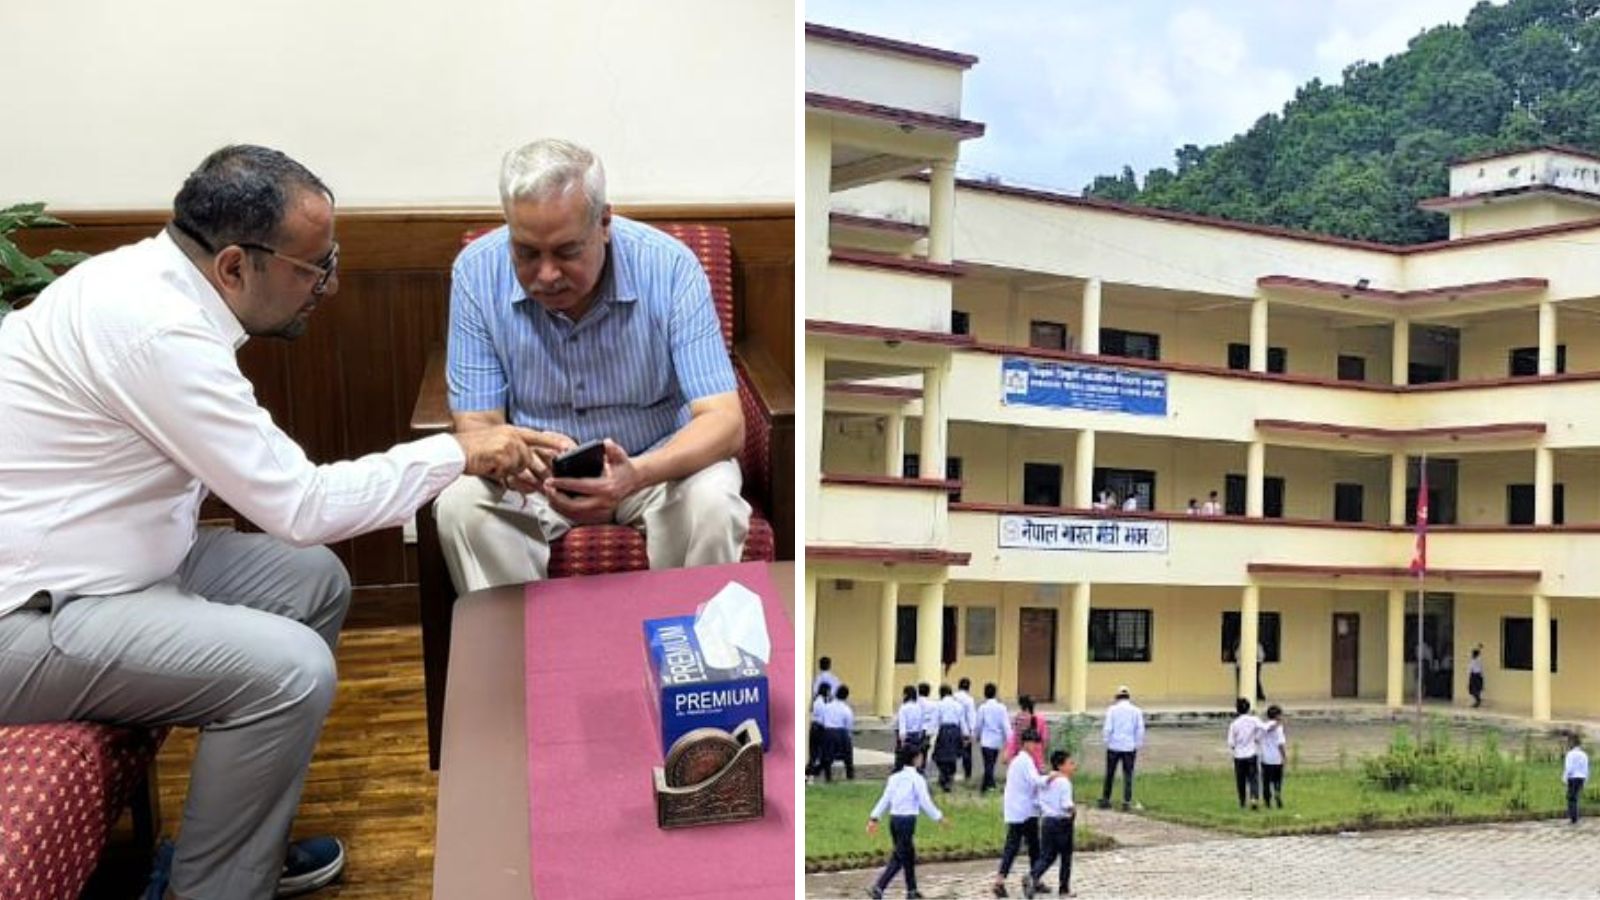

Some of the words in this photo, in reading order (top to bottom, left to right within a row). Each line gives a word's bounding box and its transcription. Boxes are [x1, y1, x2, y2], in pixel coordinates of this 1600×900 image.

[1021, 519, 1058, 543] नेपाल
[657, 625, 702, 683] PREMIUM
[675, 686, 759, 711] PREMIUM
